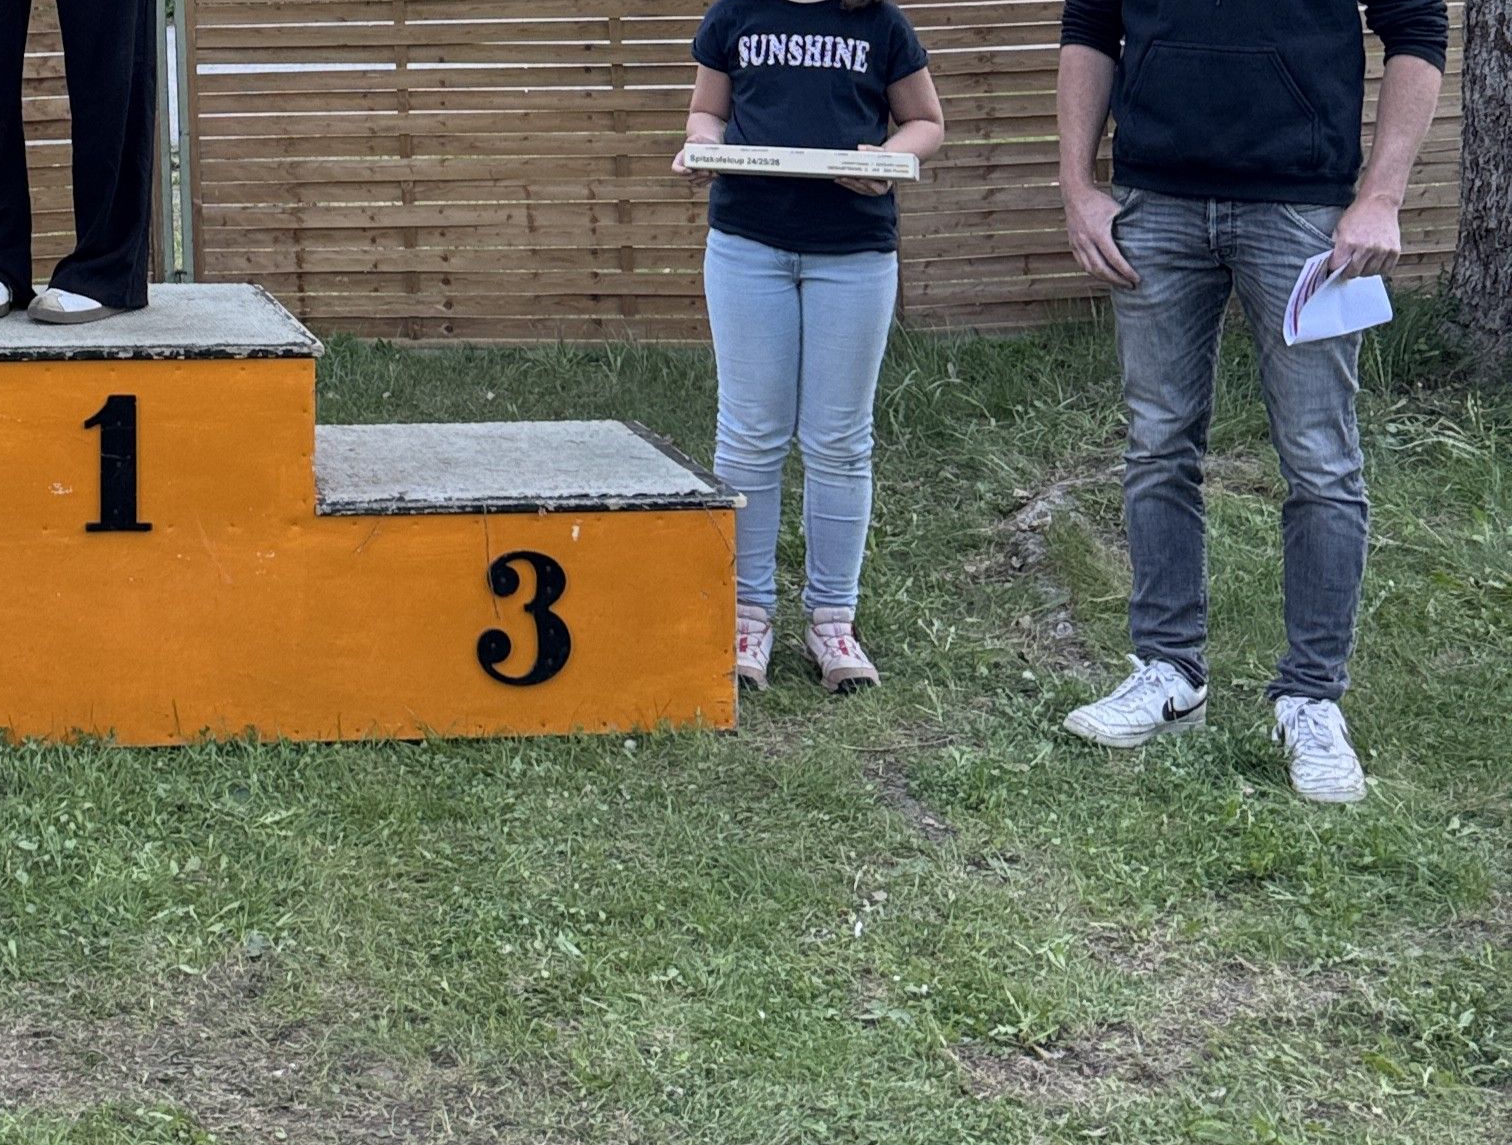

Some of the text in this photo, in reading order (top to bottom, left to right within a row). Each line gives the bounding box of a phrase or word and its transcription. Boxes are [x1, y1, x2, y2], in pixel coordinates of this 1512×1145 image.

[738, 33, 871, 74] SUNSHINE
[84, 395, 153, 532] 1
[477, 551, 571, 686] 3
